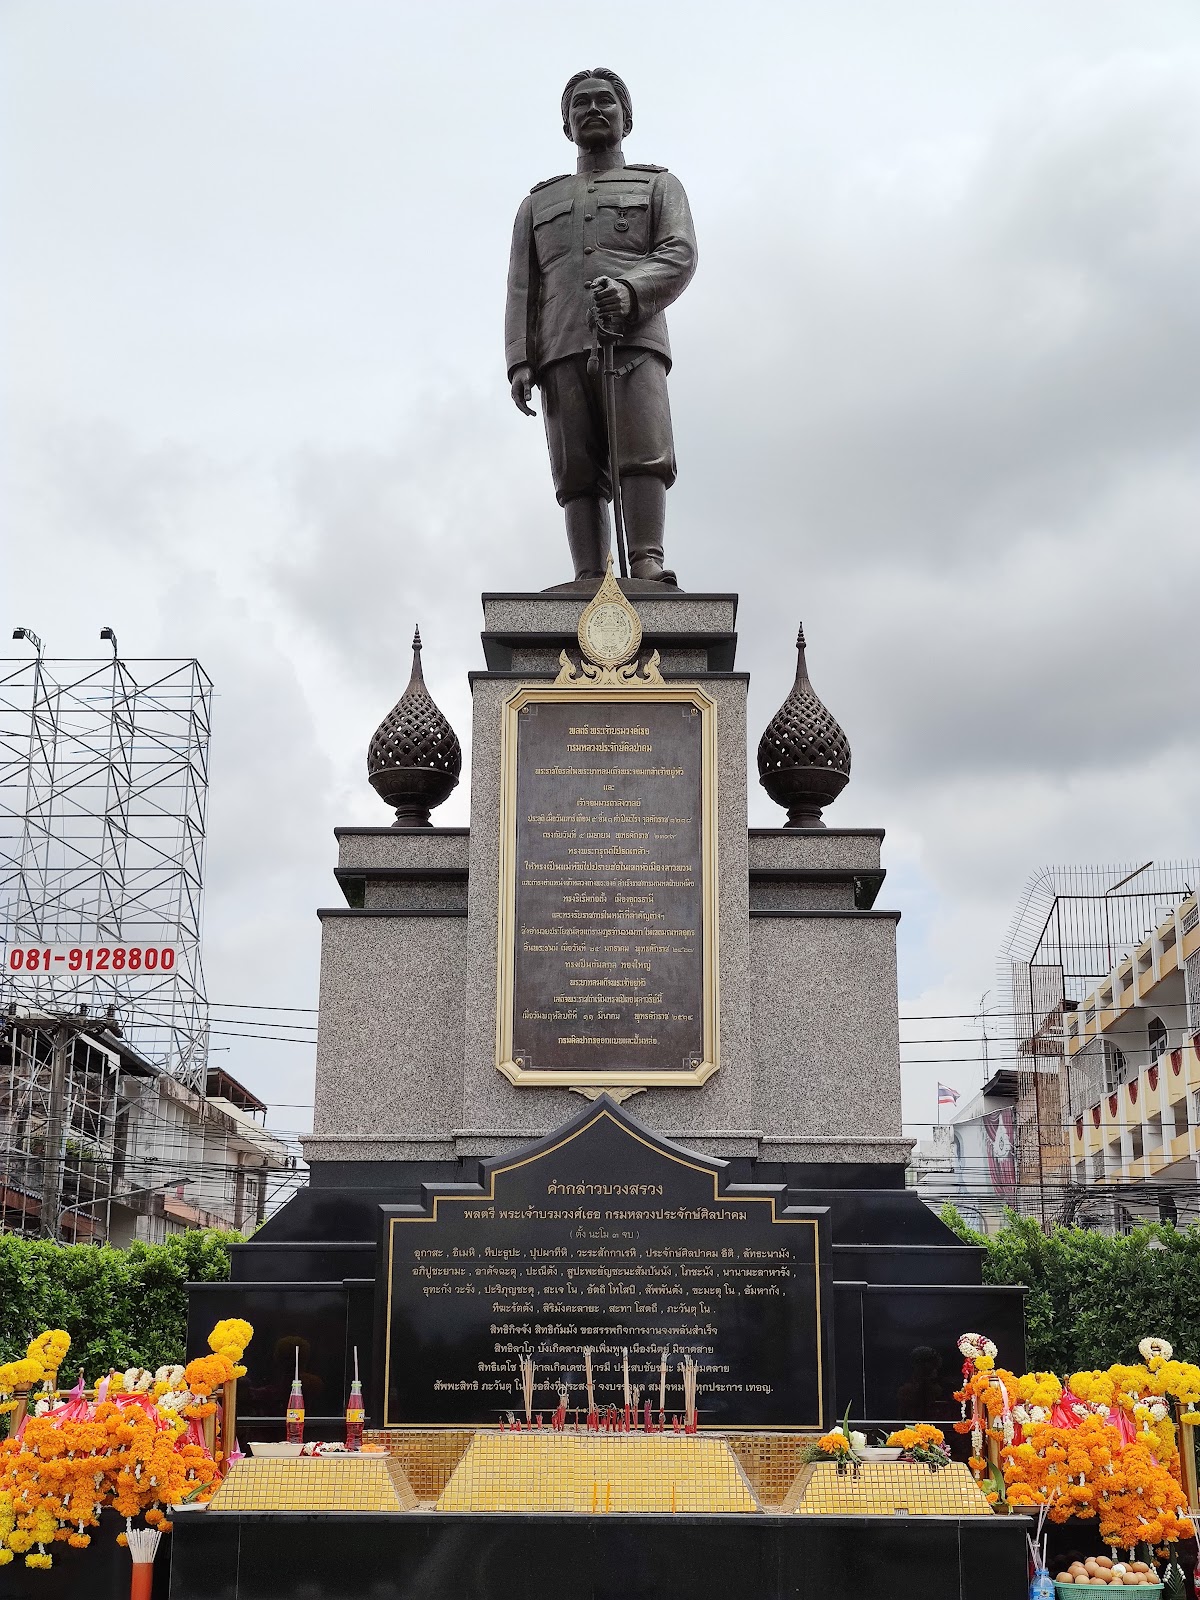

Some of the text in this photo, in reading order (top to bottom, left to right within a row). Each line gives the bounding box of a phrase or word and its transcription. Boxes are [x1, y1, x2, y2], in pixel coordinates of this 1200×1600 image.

[568, 723, 650, 736] พลตรี พระเจ้าบรมวงศ์เธอ
[566, 740, 653, 753] กรมหลวงประจักษ์ศิลปาคม
[9, 947, 175, 971] 081-9128800
[547, 1179, 664, 1196] คำกล่าวบวงสรวง
[463, 1204, 747, 1221] พลตรี พระเจ้าบรมวงศ์เธอ กรมหลวงประจักษ์ศิลปาคม
[413, 1249, 444, 1260] อุกาสะ
[645, 1247, 719, 1258] ประจักษ์ศิลปาคม
[489, 1323, 532, 1335] สิทธิกิจจัง
[580, 1323, 719, 1336] ขอสรรพกิจการงานจงพลันสำเร็จ
[494, 1341, 535, 1353] สิทธิลาโภ
